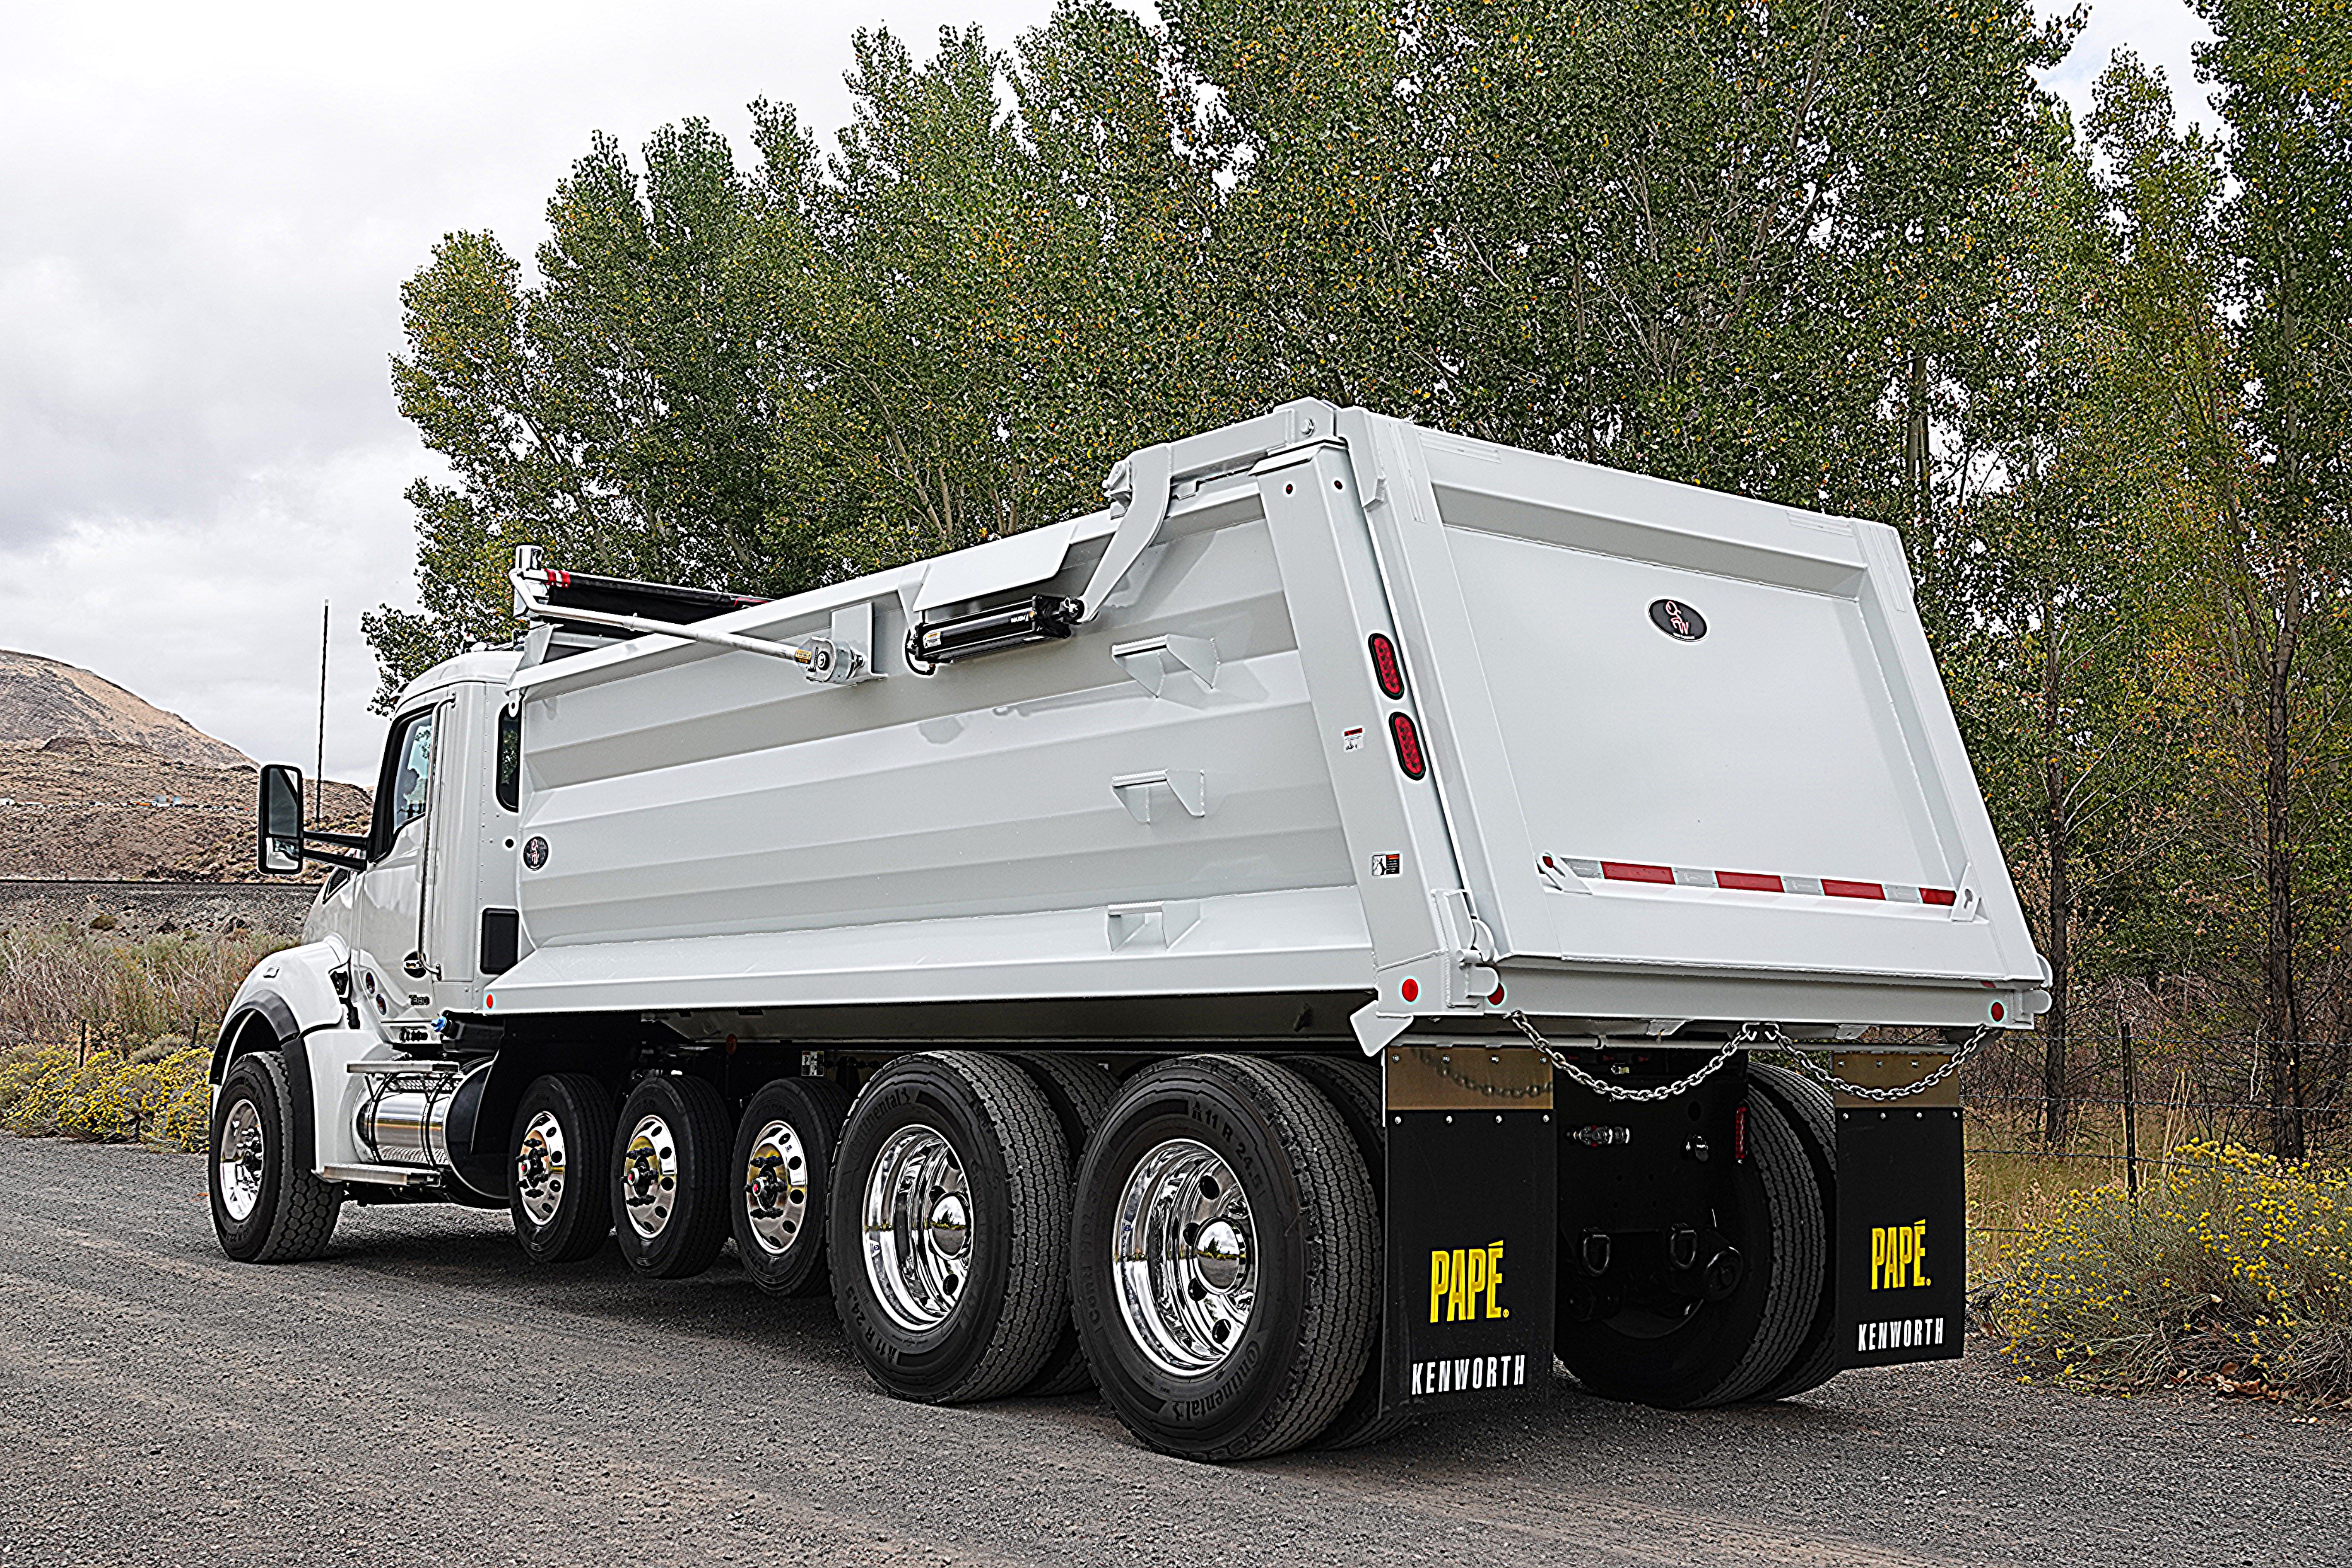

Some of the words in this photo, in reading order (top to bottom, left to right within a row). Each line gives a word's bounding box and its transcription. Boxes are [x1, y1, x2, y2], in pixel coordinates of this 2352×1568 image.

[1222, 1122, 1233, 1143] R
[1235, 1142, 1263, 1189] 24.5
[845, 1286, 866, 1326] 24.5
[865, 1326, 876, 1344] R
[1859, 1318, 1943, 1351] KENWORTH
[1412, 1355, 1525, 1395] KENWORTH
